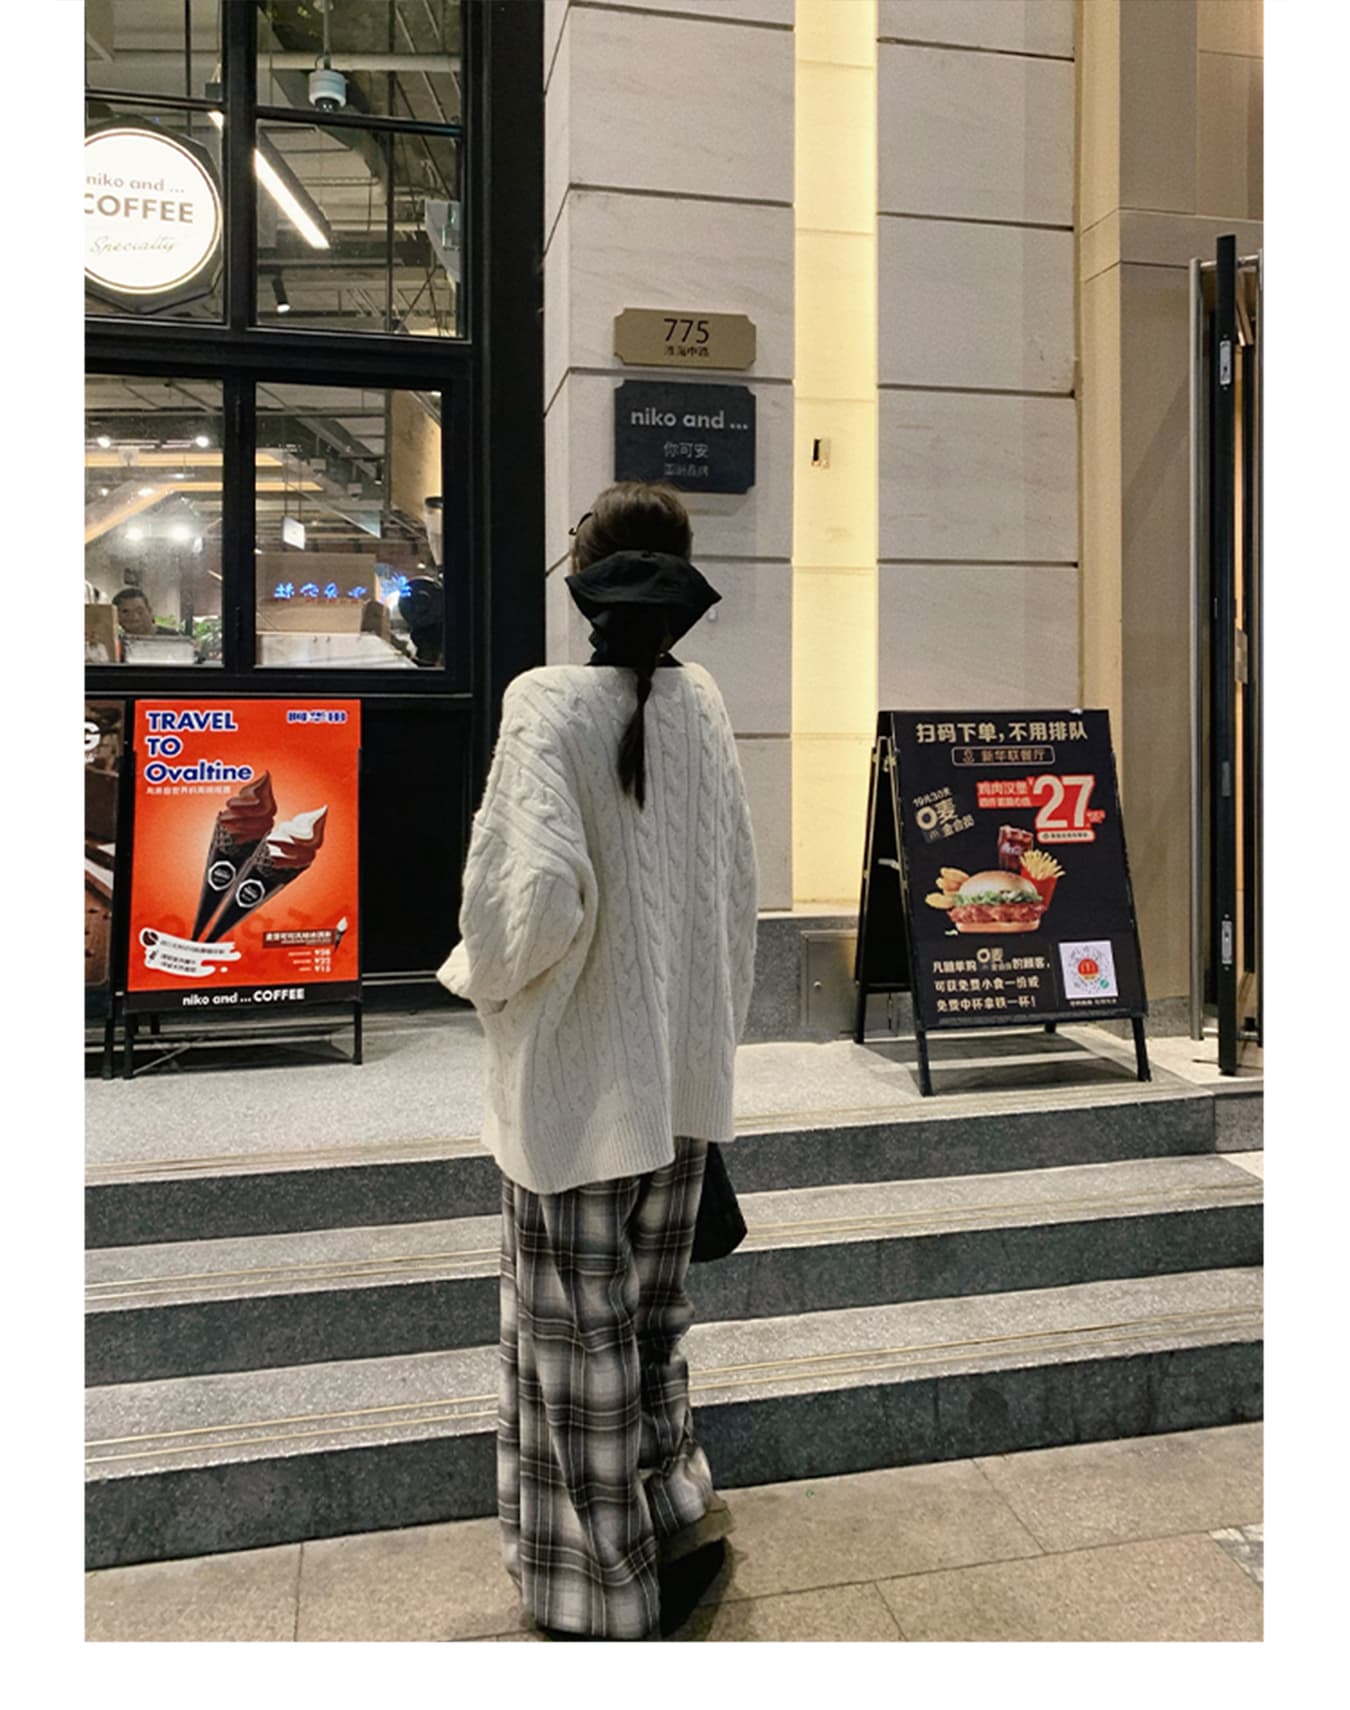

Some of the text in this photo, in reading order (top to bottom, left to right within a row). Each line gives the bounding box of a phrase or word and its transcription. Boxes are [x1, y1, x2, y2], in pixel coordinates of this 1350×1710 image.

[86, 172, 124, 188] niko
[129, 178, 164, 191] and
[89, 234, 175, 256] Specialty
[664, 318, 710, 344] 775
[631, 407, 677, 427] niko
[683, 410, 724, 429] and
[663, 441, 709, 458] 你可安
[147, 711, 237, 731] TRAVEL
[146, 737, 182, 756] TO
[145, 760, 254, 782] Ovaltine
[182, 994, 210, 1006] niko
[212, 992, 238, 1004] and
[253, 988, 305, 1002] COFFEE
